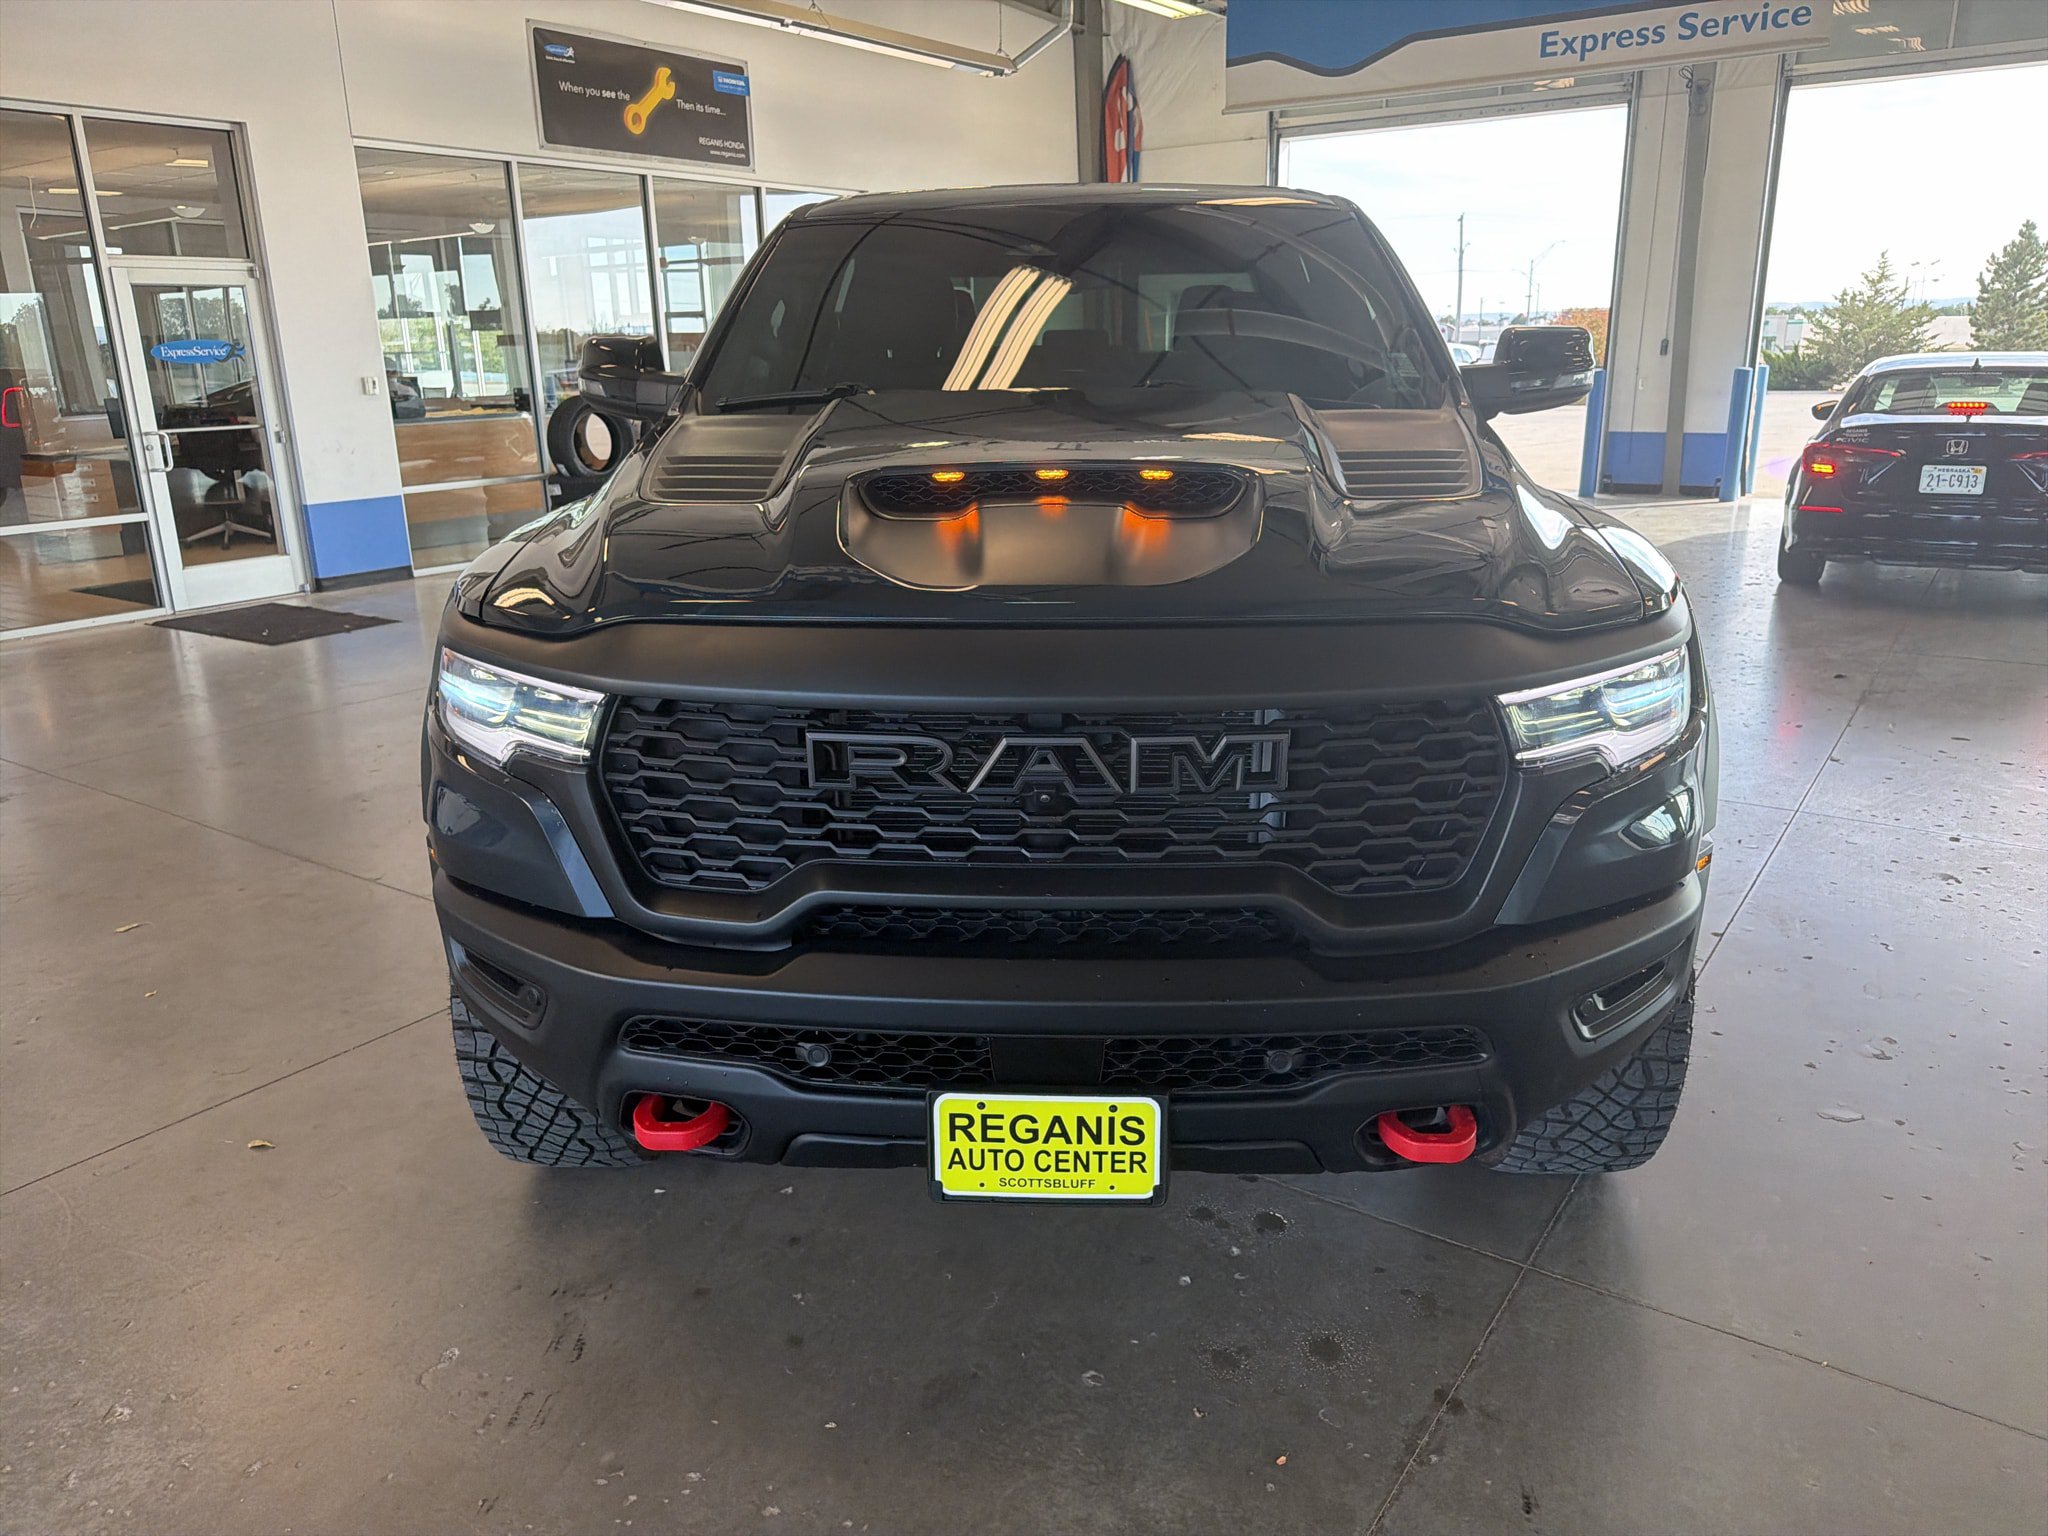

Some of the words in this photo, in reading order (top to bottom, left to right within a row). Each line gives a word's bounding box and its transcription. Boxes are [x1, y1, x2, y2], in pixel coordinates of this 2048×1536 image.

[1539, 25, 1666, 62] Express
[1677, 2, 1813, 41] Service
[558, 80, 584, 94] When
[585, 87, 600, 98] you
[601, 89, 616, 99] see
[617, 89, 631, 101] the
[676, 98, 695, 111] Then
[695, 102, 705, 113] its
[698, 136, 723, 148] REGANIS
[723, 140, 746, 150] HONDA
[160, 346, 227, 359] ExpressService
[1926, 473, 1979, 489] 21-C913
[805, 731, 1291, 794] RAM
[948, 1112, 1146, 1146] REGANIS
[947, 1147, 1025, 1172] AUTO
[1033, 1149, 1148, 1174] CENTER
[998, 1177, 1096, 1189] SCOTTSBLUFF
